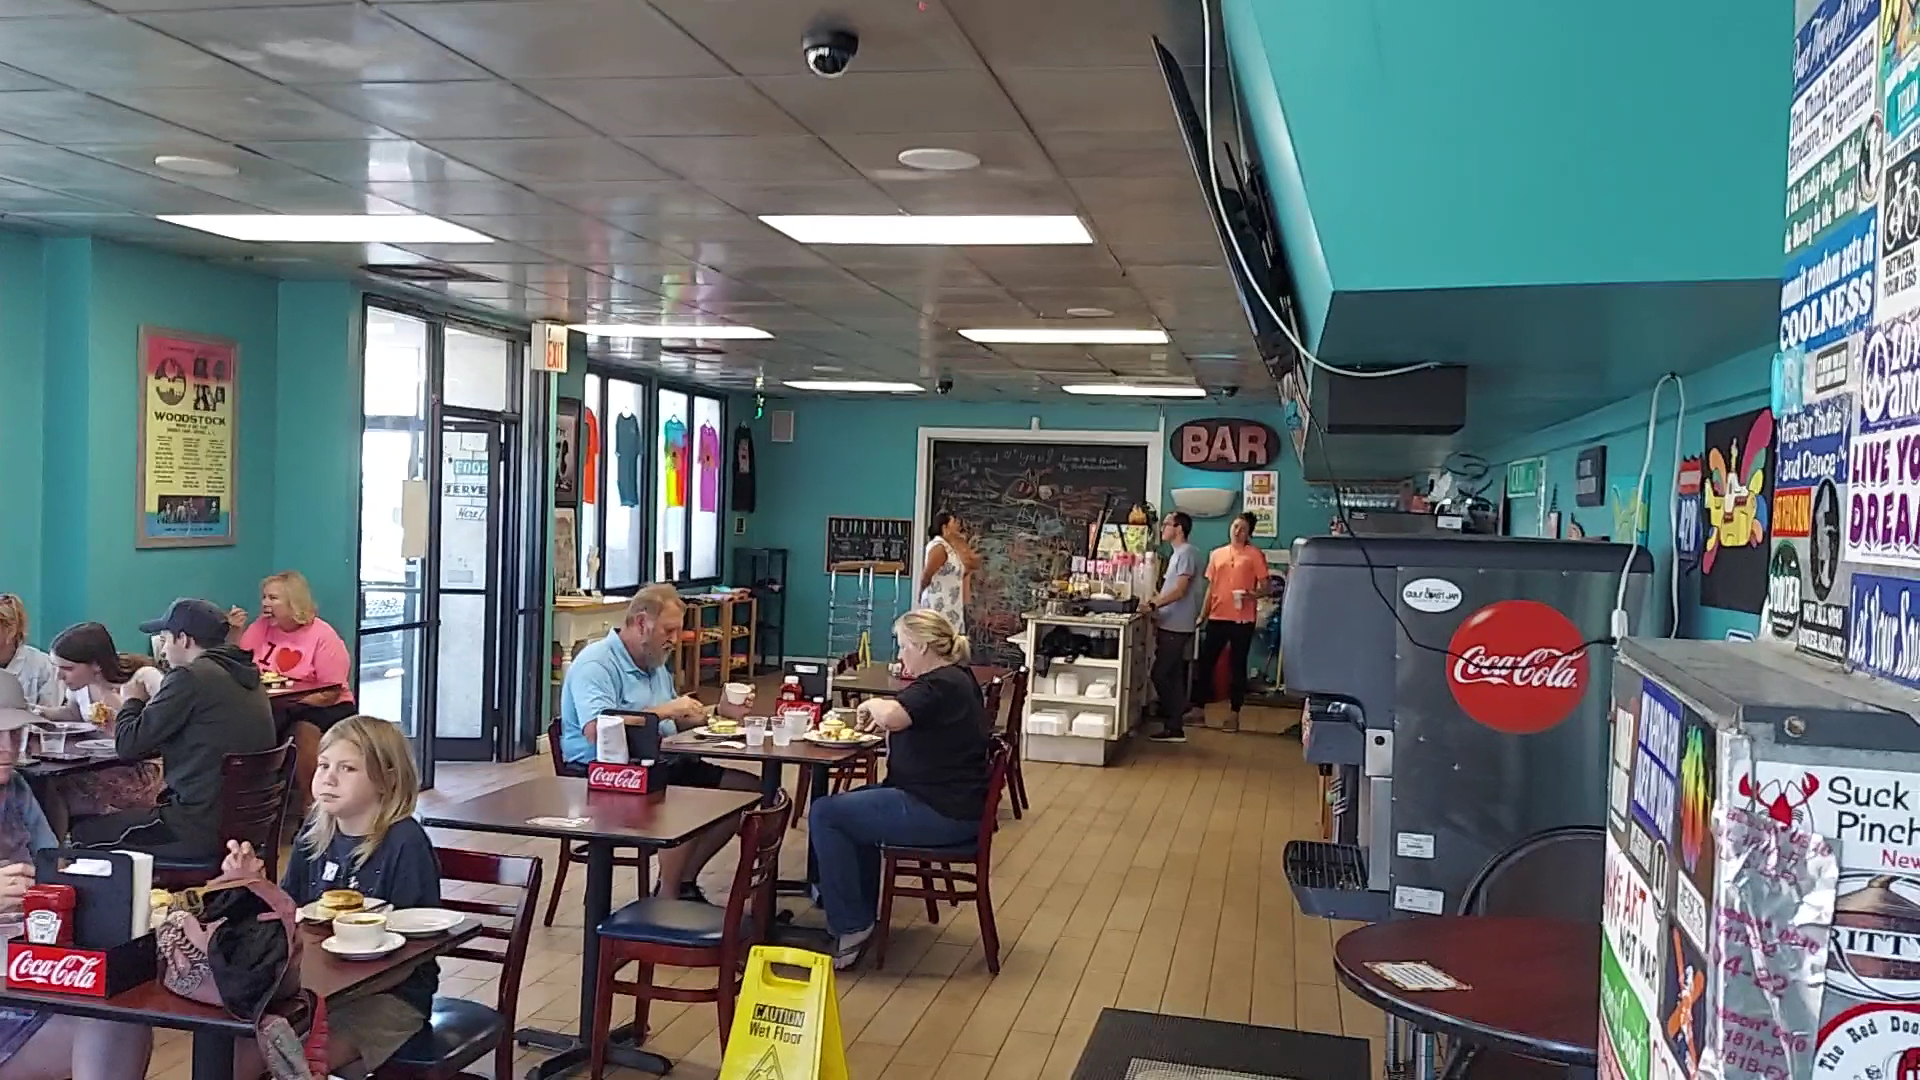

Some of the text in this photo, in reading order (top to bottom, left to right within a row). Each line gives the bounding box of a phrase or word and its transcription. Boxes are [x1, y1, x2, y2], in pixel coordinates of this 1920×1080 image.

[1805, 80, 1828, 127] Think
[1829, 35, 1873, 105] Education
[1822, 112, 1835, 143] Try
[1836, 76, 1872, 133] Ignorance
[1841, 233, 1862, 279] acts
[1863, 218, 1875, 266] of
[1885, 248, 1914, 277] BETWEEN
[1900, 266, 1917, 290] LEGS
[1780, 270, 1872, 352] COOLNESS
[547, 341, 565, 369] EXIT
[153, 411, 226, 426] WOODSTOCK
[1182, 425, 1267, 465] BAR
[1852, 438, 1891, 486] LIVE
[1783, 449, 1836, 481] and Dance
[1246, 495, 1276, 506] MILE
[1405, 590, 1423, 598] GULF
[1424, 588, 1445, 600] COAST
[1803, 602, 1815, 624] NOT
[1815, 605, 1828, 626] ALL
[1828, 606, 1843, 630] WHO
[1848, 584, 1869, 665] Let
[1869, 584, 1899, 672] Your
[1454, 645, 1585, 688] Coca-Cola
[590, 766, 645, 789] Coca-Cola
[1827, 775, 1910, 811] Suck
[1623, 871, 1647, 937] ART
[1619, 922, 1638, 969] NOT
[9, 950, 103, 988] Coca-Cola
[749, 1021, 804, 1045] Wet Floor
[755, 1005, 805, 1027] CAUTION
[1819, 1043, 1845, 1072] The
[1846, 1018, 1879, 1044] Red
